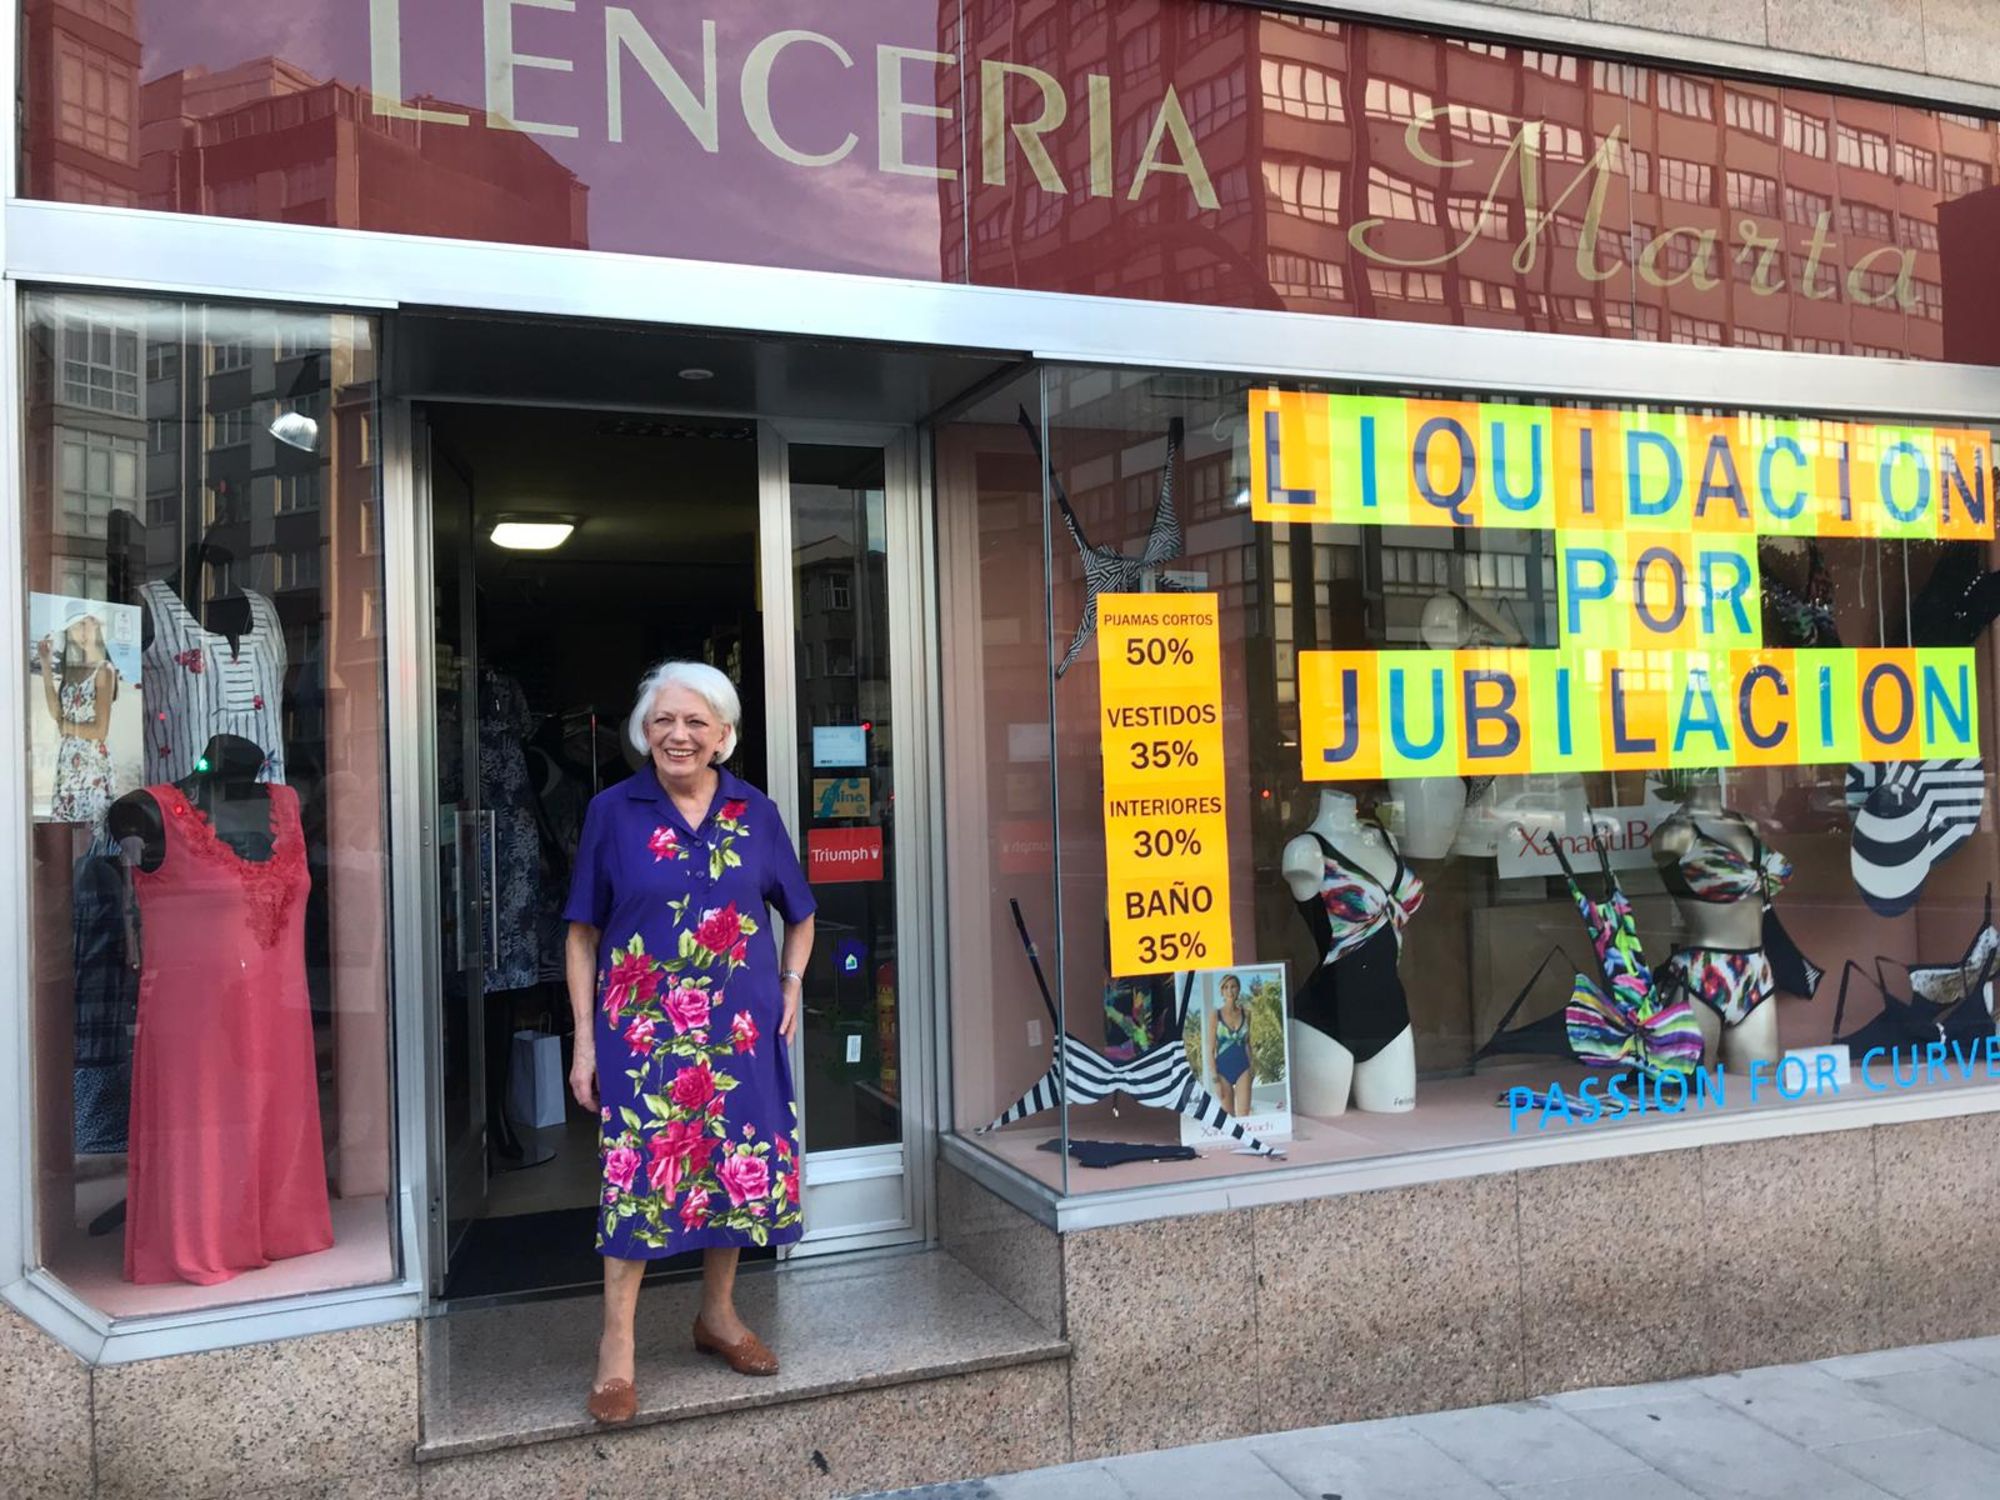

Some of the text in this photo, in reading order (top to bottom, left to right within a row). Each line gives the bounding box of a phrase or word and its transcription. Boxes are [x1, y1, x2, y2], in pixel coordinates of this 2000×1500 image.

[370, 0, 1222, 210] LENCERIA
[1348, 104, 1923, 309] Marta
[1264, 411, 1986, 525] LIQUIDACION
[1566, 546, 1753, 635] POR
[1104, 614, 1213, 626] PIJAMAS CORTOS
[1126, 638, 1194, 666] 50%
[1107, 704, 1216, 728] VESTIDOS
[1323, 662, 1972, 762] JUBILACION
[1130, 740, 1199, 769] 35%
[1110, 797, 1222, 817] INTERIORES
[811, 847, 869, 864] Triumph
[1134, 828, 1201, 858] 30%
[1126, 881, 1213, 920] BAÑO
[1138, 931, 1207, 964] 35%
[1508, 1035, 2000, 1133] PASSION FOR CURVE
